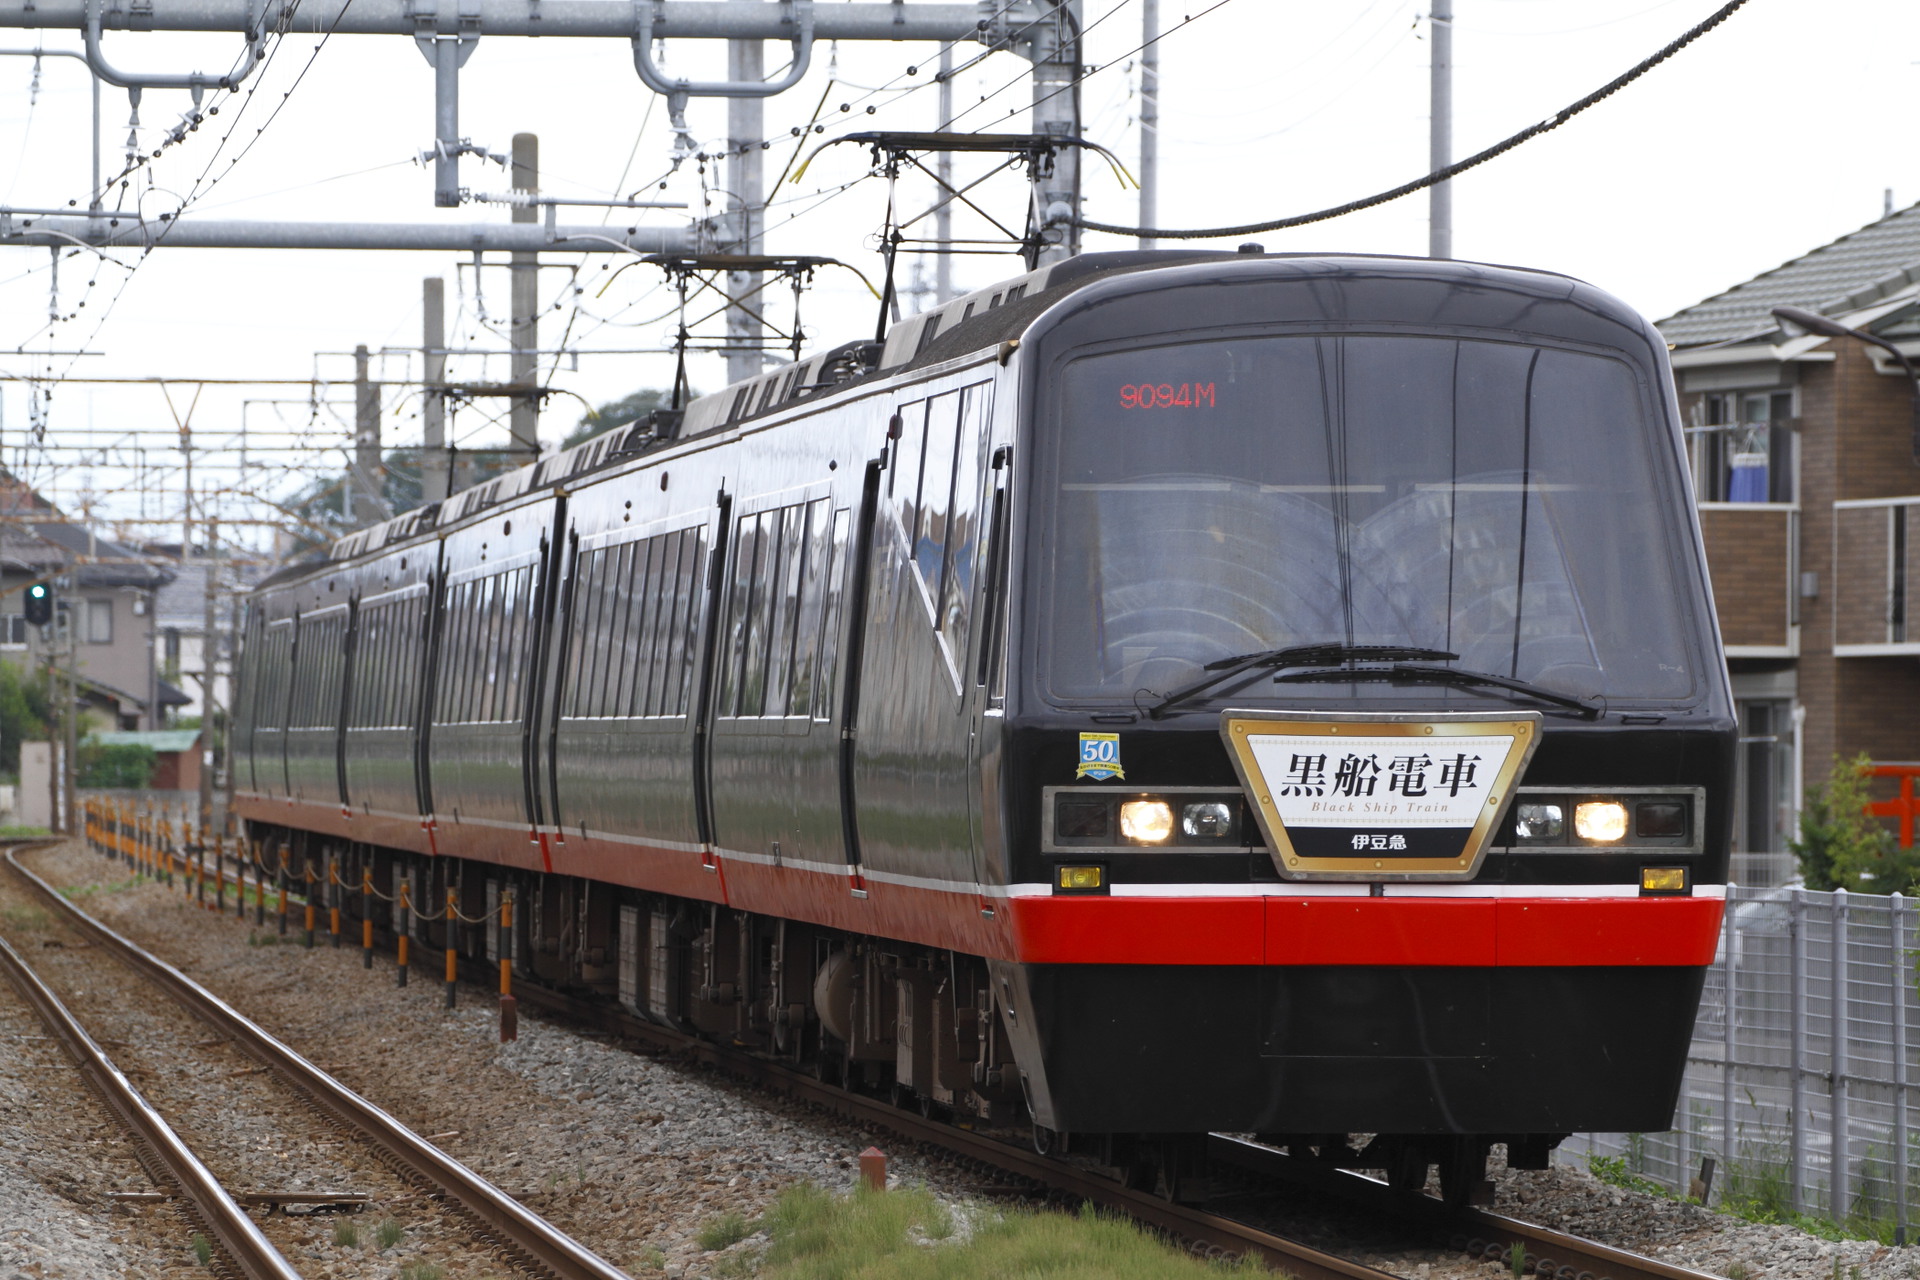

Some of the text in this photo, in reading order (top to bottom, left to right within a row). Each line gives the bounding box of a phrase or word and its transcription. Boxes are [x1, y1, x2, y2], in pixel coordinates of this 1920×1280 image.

[1120, 382, 1216, 409] 9094M
[1082, 740, 1114, 762] 50
[1280, 752, 1482, 798] 黒船電車
[1311, 801, 1449, 814] Black Ship Train
[1351, 834, 1407, 850] 伊豆急
